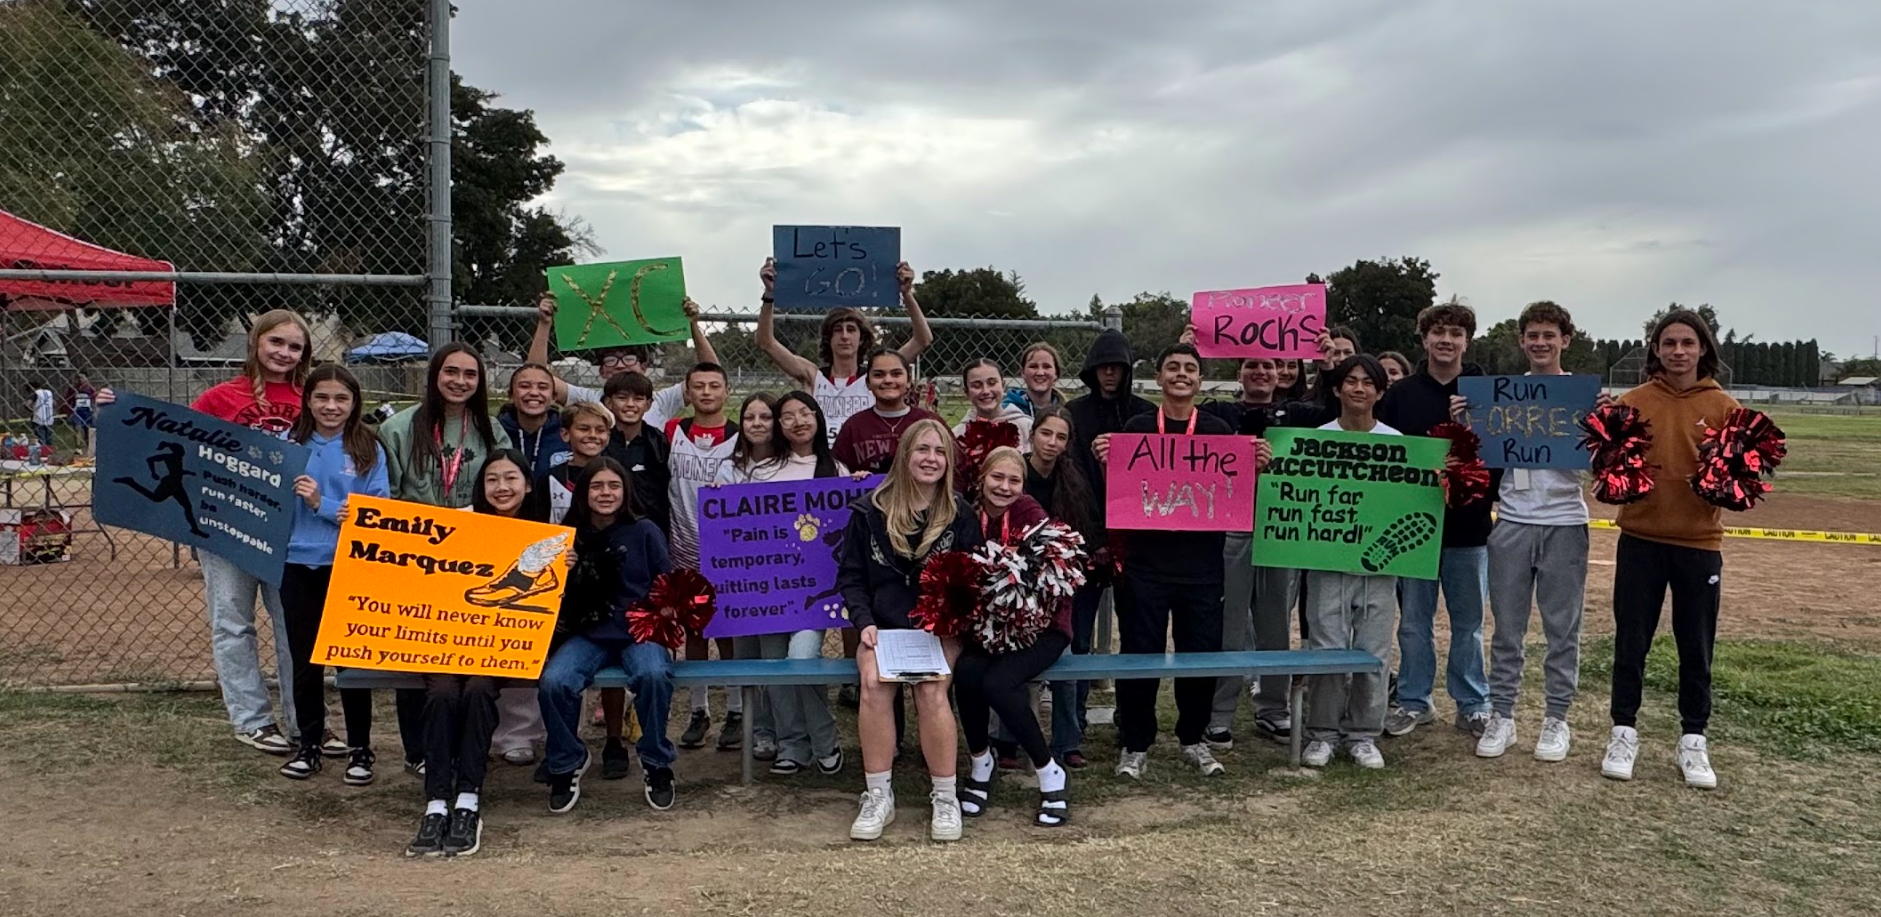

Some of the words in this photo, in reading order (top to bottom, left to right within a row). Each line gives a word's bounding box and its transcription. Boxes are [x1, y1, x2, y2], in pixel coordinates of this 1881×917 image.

[794, 228, 867, 259] Let's
[803, 260, 878, 298] GO!
[561, 263, 687, 347] XC
[1494, 377, 1547, 402] Run
[121, 406, 243, 452] Natalie
[1127, 435, 1176, 471] All
[1182, 439, 1238, 476] the
[1503, 438, 1551, 463] Run
[198, 445, 282, 488] Hoggard
[201, 500, 217, 512] be
[202, 486, 226, 500] run
[228, 494, 268, 522] faster,
[203, 470, 237, 488] Push
[239, 483, 282, 512] harder,
[703, 492, 797, 519] CLAIRE
[805, 488, 874, 511] MOH
[1141, 475, 1233, 519] WAY!
[354, 507, 456, 545] Emily
[1268, 506, 1302, 523] run
[199, 516, 273, 555] unstoppable
[773, 525, 789, 540] is
[1264, 525, 1299, 541] run
[1724, 527, 1751, 535] AUTION
[1763, 527, 1795, 538] CAUTION
[1825, 531, 1857, 541] CAUTION
[349, 540, 494, 577] Marquez
[715, 578, 769, 595] uitting
[774, 575, 817, 590] lasts
[397, 603, 432, 620] will
[436, 609, 490, 625] never
[493, 612, 545, 630] know
[344, 622, 391, 638] your
[394, 625, 448, 645] limits
[453, 634, 495, 648] until
[498, 638, 533, 652] you
[325, 645, 372, 661] push
[376, 650, 456, 666] yourself
[458, 654, 475, 667] to
